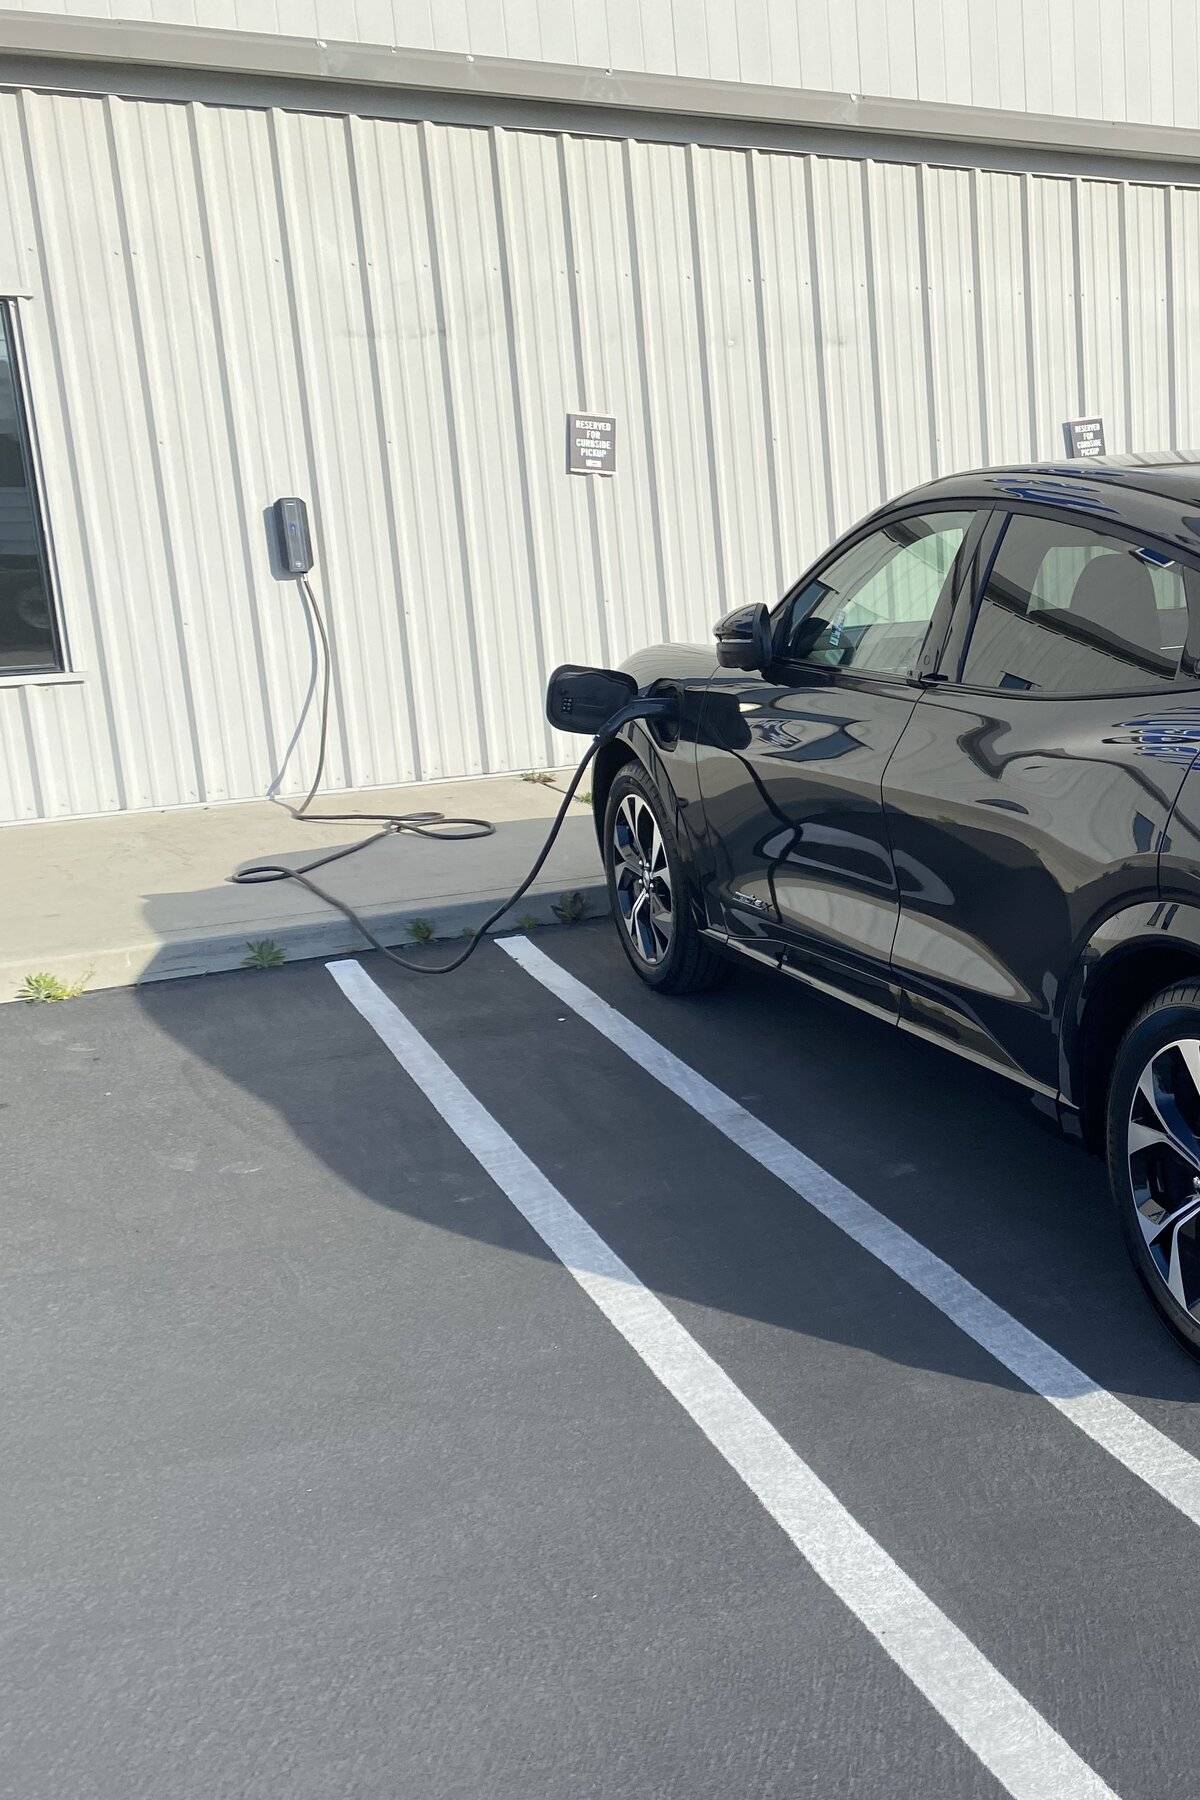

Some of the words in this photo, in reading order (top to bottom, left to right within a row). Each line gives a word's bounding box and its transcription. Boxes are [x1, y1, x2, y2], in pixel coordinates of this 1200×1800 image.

[575, 420, 611, 431] RESERVED
[1074, 423, 1100, 433] RESERVED
[586, 430, 601, 440] FOR
[1083, 432, 1094, 441] FOR
[575, 438, 612, 450] CURBSIDE
[580, 447, 607, 458] PICKUP
